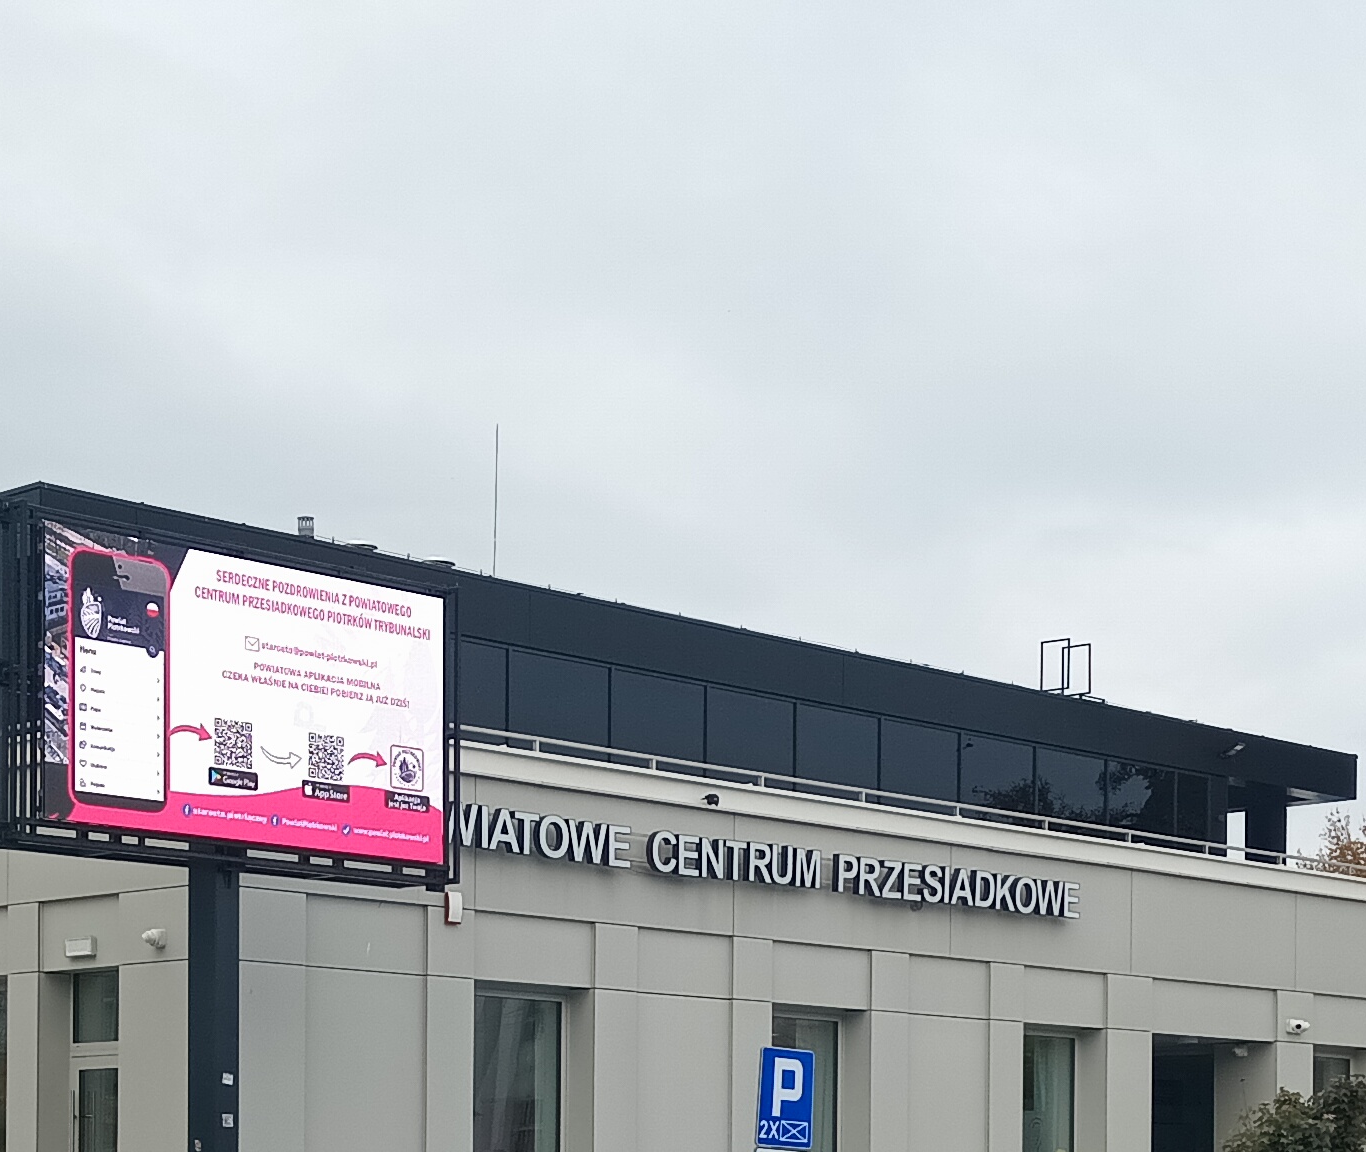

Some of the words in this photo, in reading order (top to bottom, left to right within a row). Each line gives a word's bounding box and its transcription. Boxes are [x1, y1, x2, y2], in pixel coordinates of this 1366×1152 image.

[194, 586, 240, 606] CENTRUM
[242, 595, 325, 621] PRZESIADKOWEGO
[327, 610, 373, 630] PIOTRKÓW
[374, 619, 431, 640] TRYBUNALSKI
[216, 569, 270, 591] SERDECZNE
[272, 580, 340, 604] POZDROWIENIA
[342, 593, 348, 606] Z
[349, 595, 412, 618] POWIATOWEGO
[221, 670, 249, 683] CZEKA
[288, 680, 300, 690] NA
[253, 661, 302, 677] POWIATOWA
[303, 670, 345, 684] APLIKACJA
[346, 677, 381, 691] MOBILNA
[222, 776, 243, 787] Google
[243, 778, 256, 789] Play
[314, 788, 329, 800] App
[330, 791, 348, 801] Store
[649, 830, 822, 890] CENTRUM
[834, 853, 1081, 920] PRZESIADKOWE
[771, 1057, 804, 1117] P
